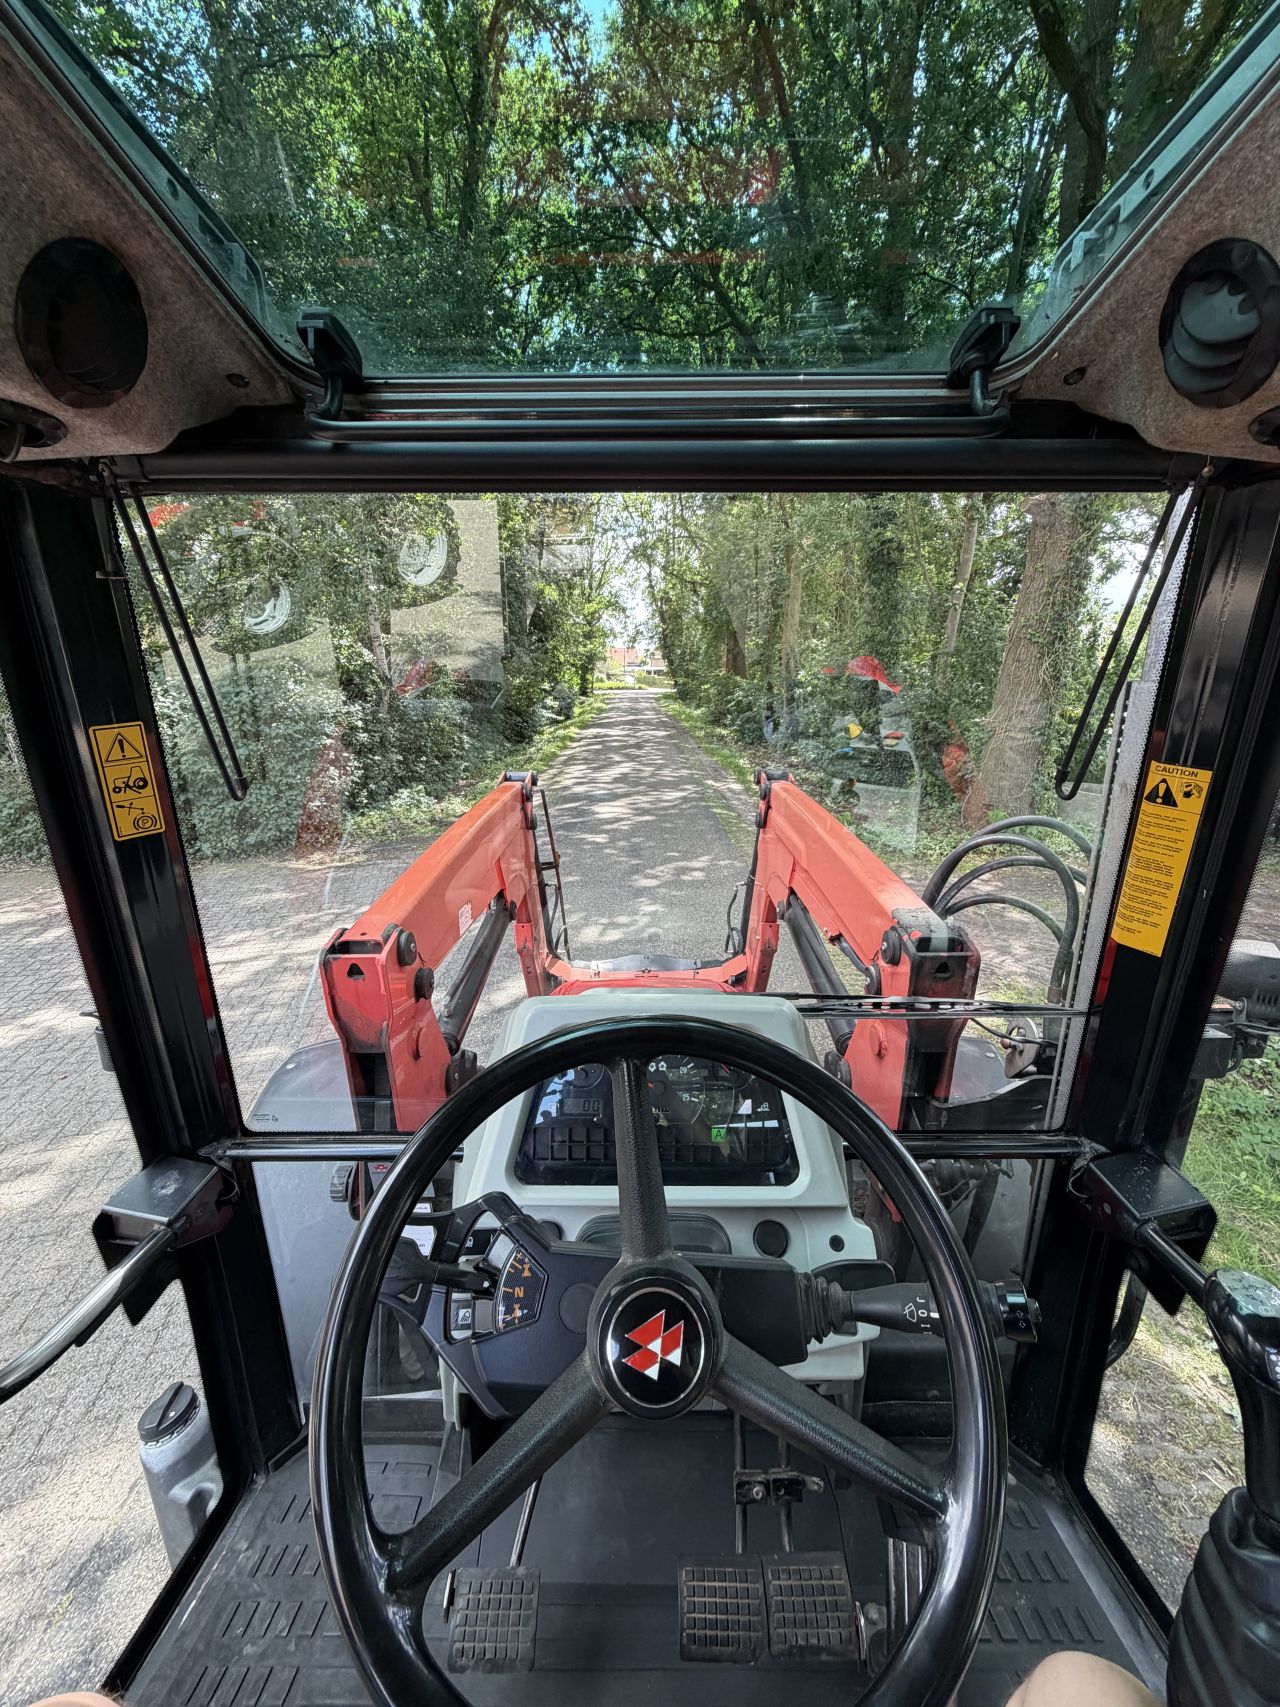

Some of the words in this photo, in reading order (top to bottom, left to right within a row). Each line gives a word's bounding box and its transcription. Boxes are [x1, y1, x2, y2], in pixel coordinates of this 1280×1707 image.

[1155, 765, 1199, 778] CAUTION
[142, 818, 150, 828] P
[680, 1066, 688, 1074] 20
[682, 1093, 690, 1102] 25
[714, 1129, 724, 1141] A
[514, 1286, 524, 1298] N
